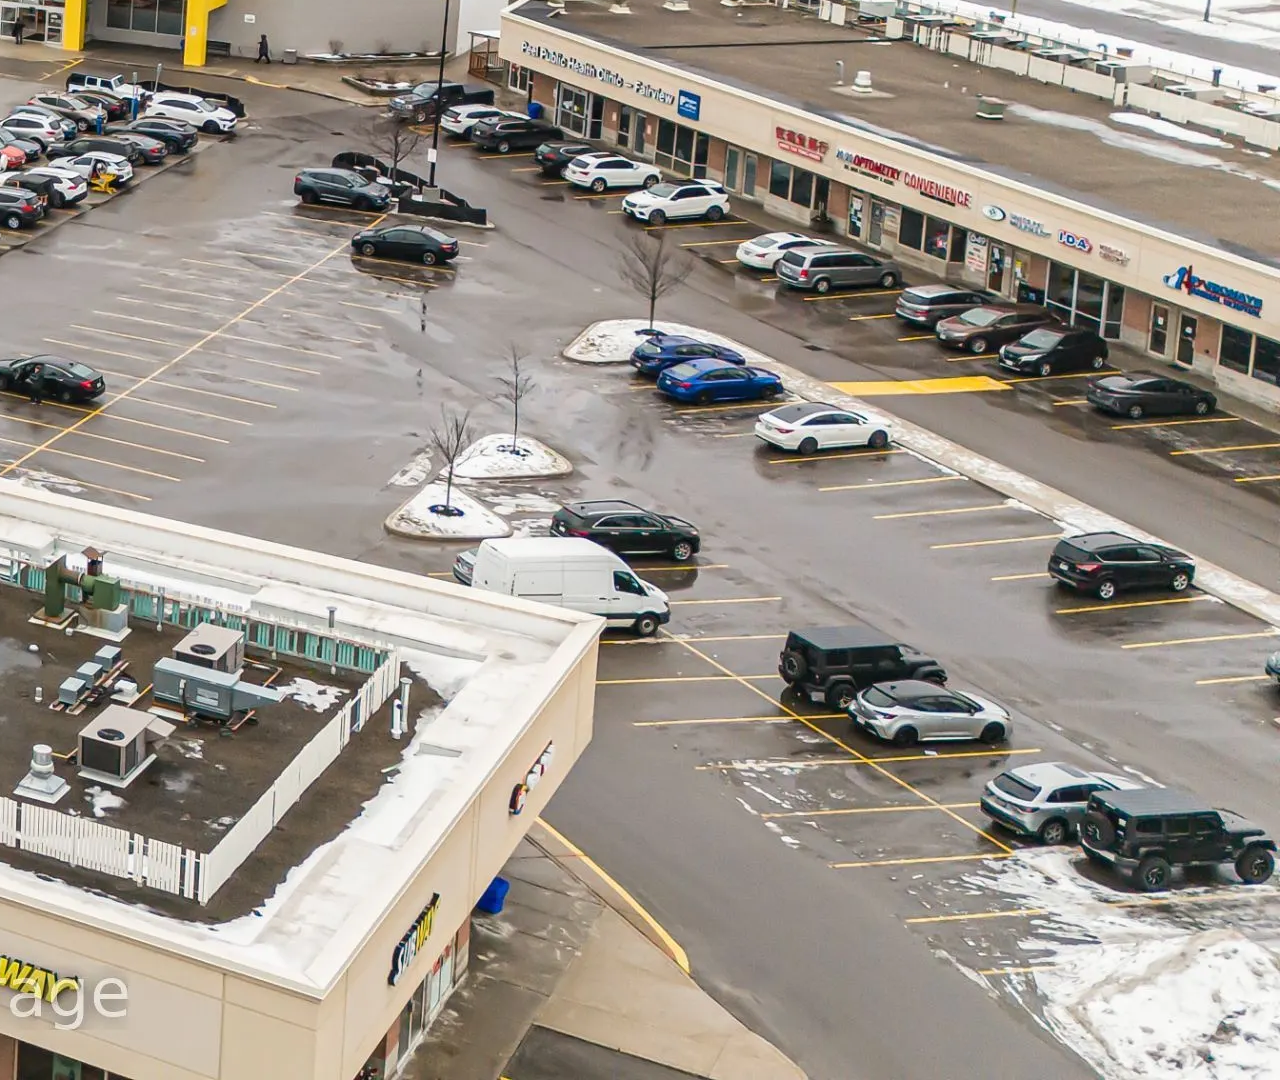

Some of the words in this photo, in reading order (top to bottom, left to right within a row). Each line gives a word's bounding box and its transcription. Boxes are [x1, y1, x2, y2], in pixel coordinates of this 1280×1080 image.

[521, 41, 541, 58] Peel
[539, 48, 568, 68] Public
[567, 57, 597, 78] Health
[596, 68, 624, 88] Clinic
[633, 81, 676, 106] Fairview
[852, 154, 902, 181] OPTOMETRY
[903, 172, 972, 209] CONVENIENCE
